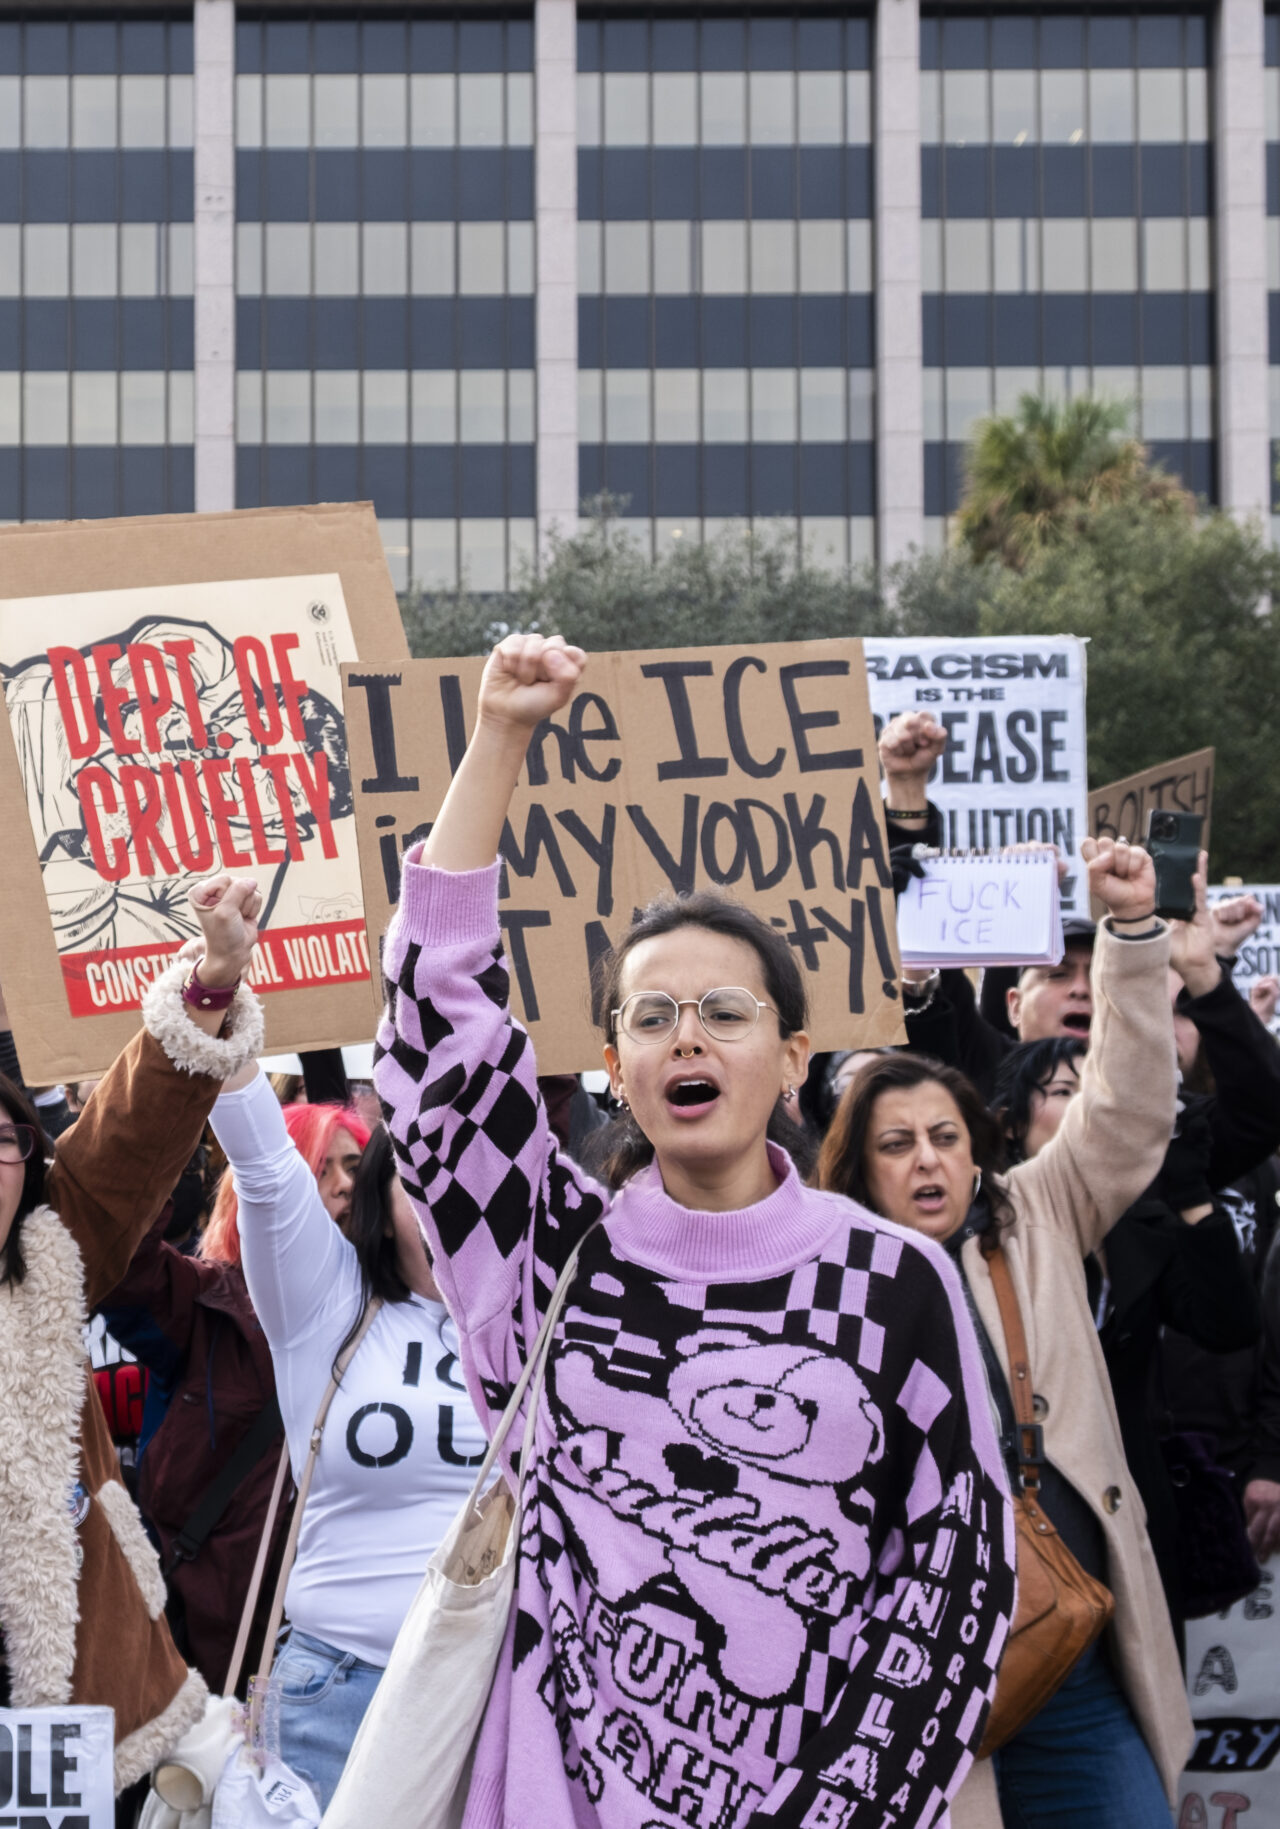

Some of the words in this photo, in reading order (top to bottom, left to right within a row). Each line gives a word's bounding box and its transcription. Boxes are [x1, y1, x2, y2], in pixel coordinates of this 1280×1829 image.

[232, 633, 309, 747] OF
[865, 653, 1069, 681] RACISM
[915, 688, 942, 702] IS
[948, 687, 1005, 702] THE
[348, 673, 420, 793] I
[439, 674, 623, 786] lke
[640, 656, 864, 781] ICE
[874, 710, 1069, 784] EASE
[77, 751, 339, 883] CRUELTY
[498, 803, 617, 917] MY
[626, 777, 893, 897] VODKA
[917, 878, 1022, 913] FUCK
[283, 931, 371, 981] VIOLATO
[940, 918, 993, 945] ICE
[346, 1402, 490, 1469] OU
